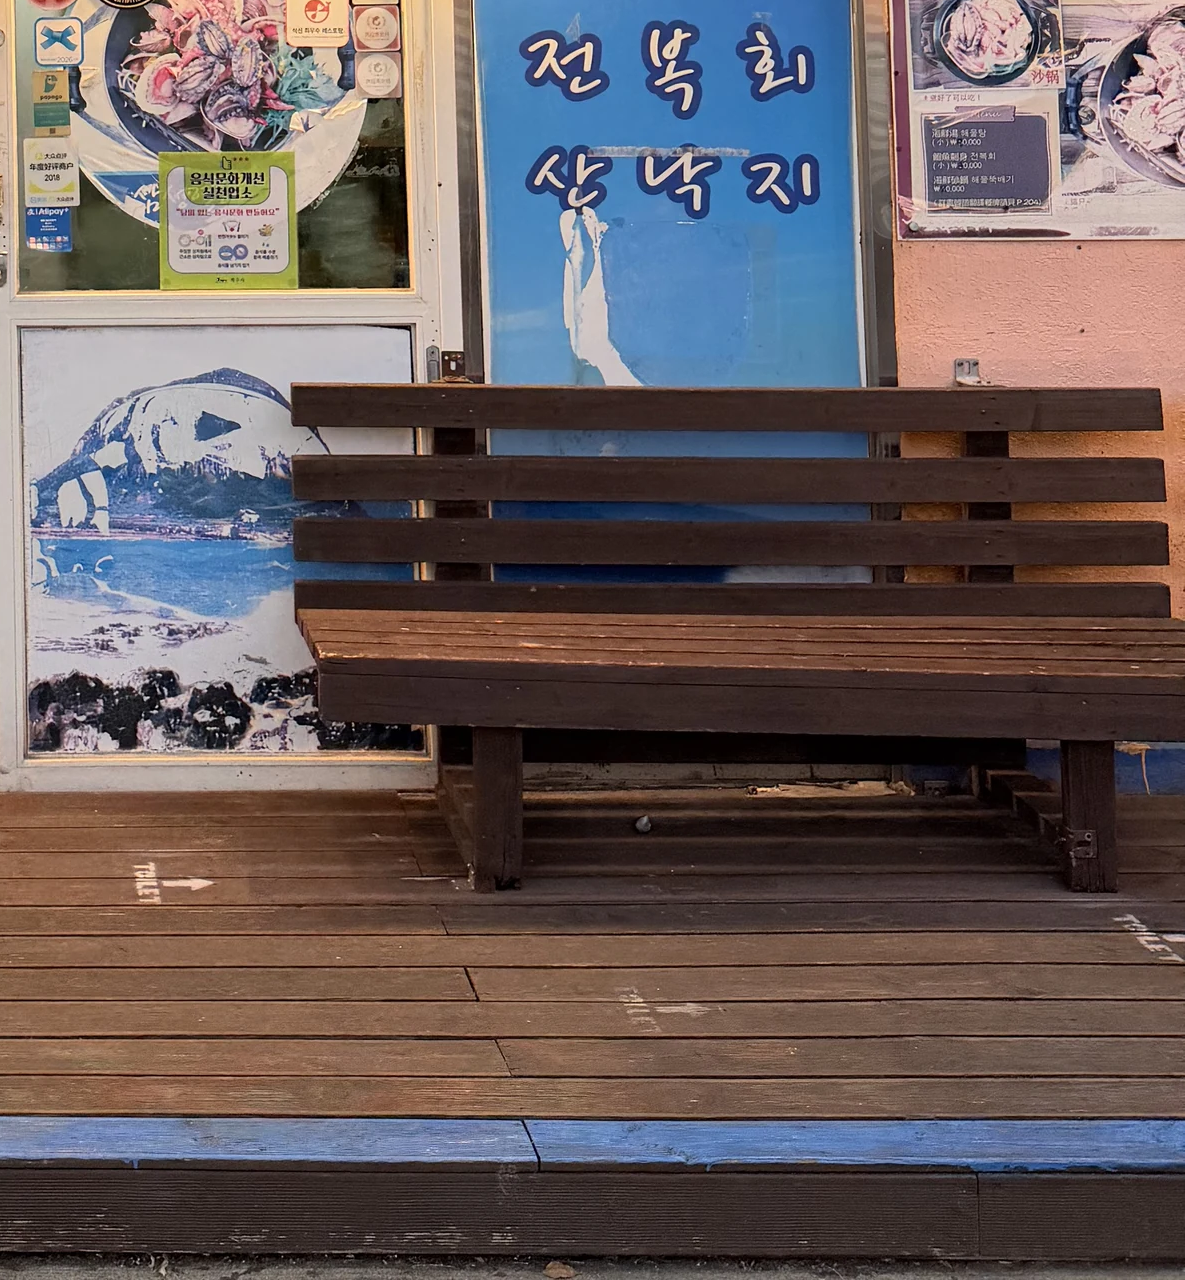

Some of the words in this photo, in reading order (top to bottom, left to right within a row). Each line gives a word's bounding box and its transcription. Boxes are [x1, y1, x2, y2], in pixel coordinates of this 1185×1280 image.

[525, 26, 808, 112] 전복회
[190, 172, 265, 185] 음식문화개선
[203, 186, 254, 200] 실천업소
[532, 151, 813, 212] 산낙지
[134, 862, 161, 904] TOILET
